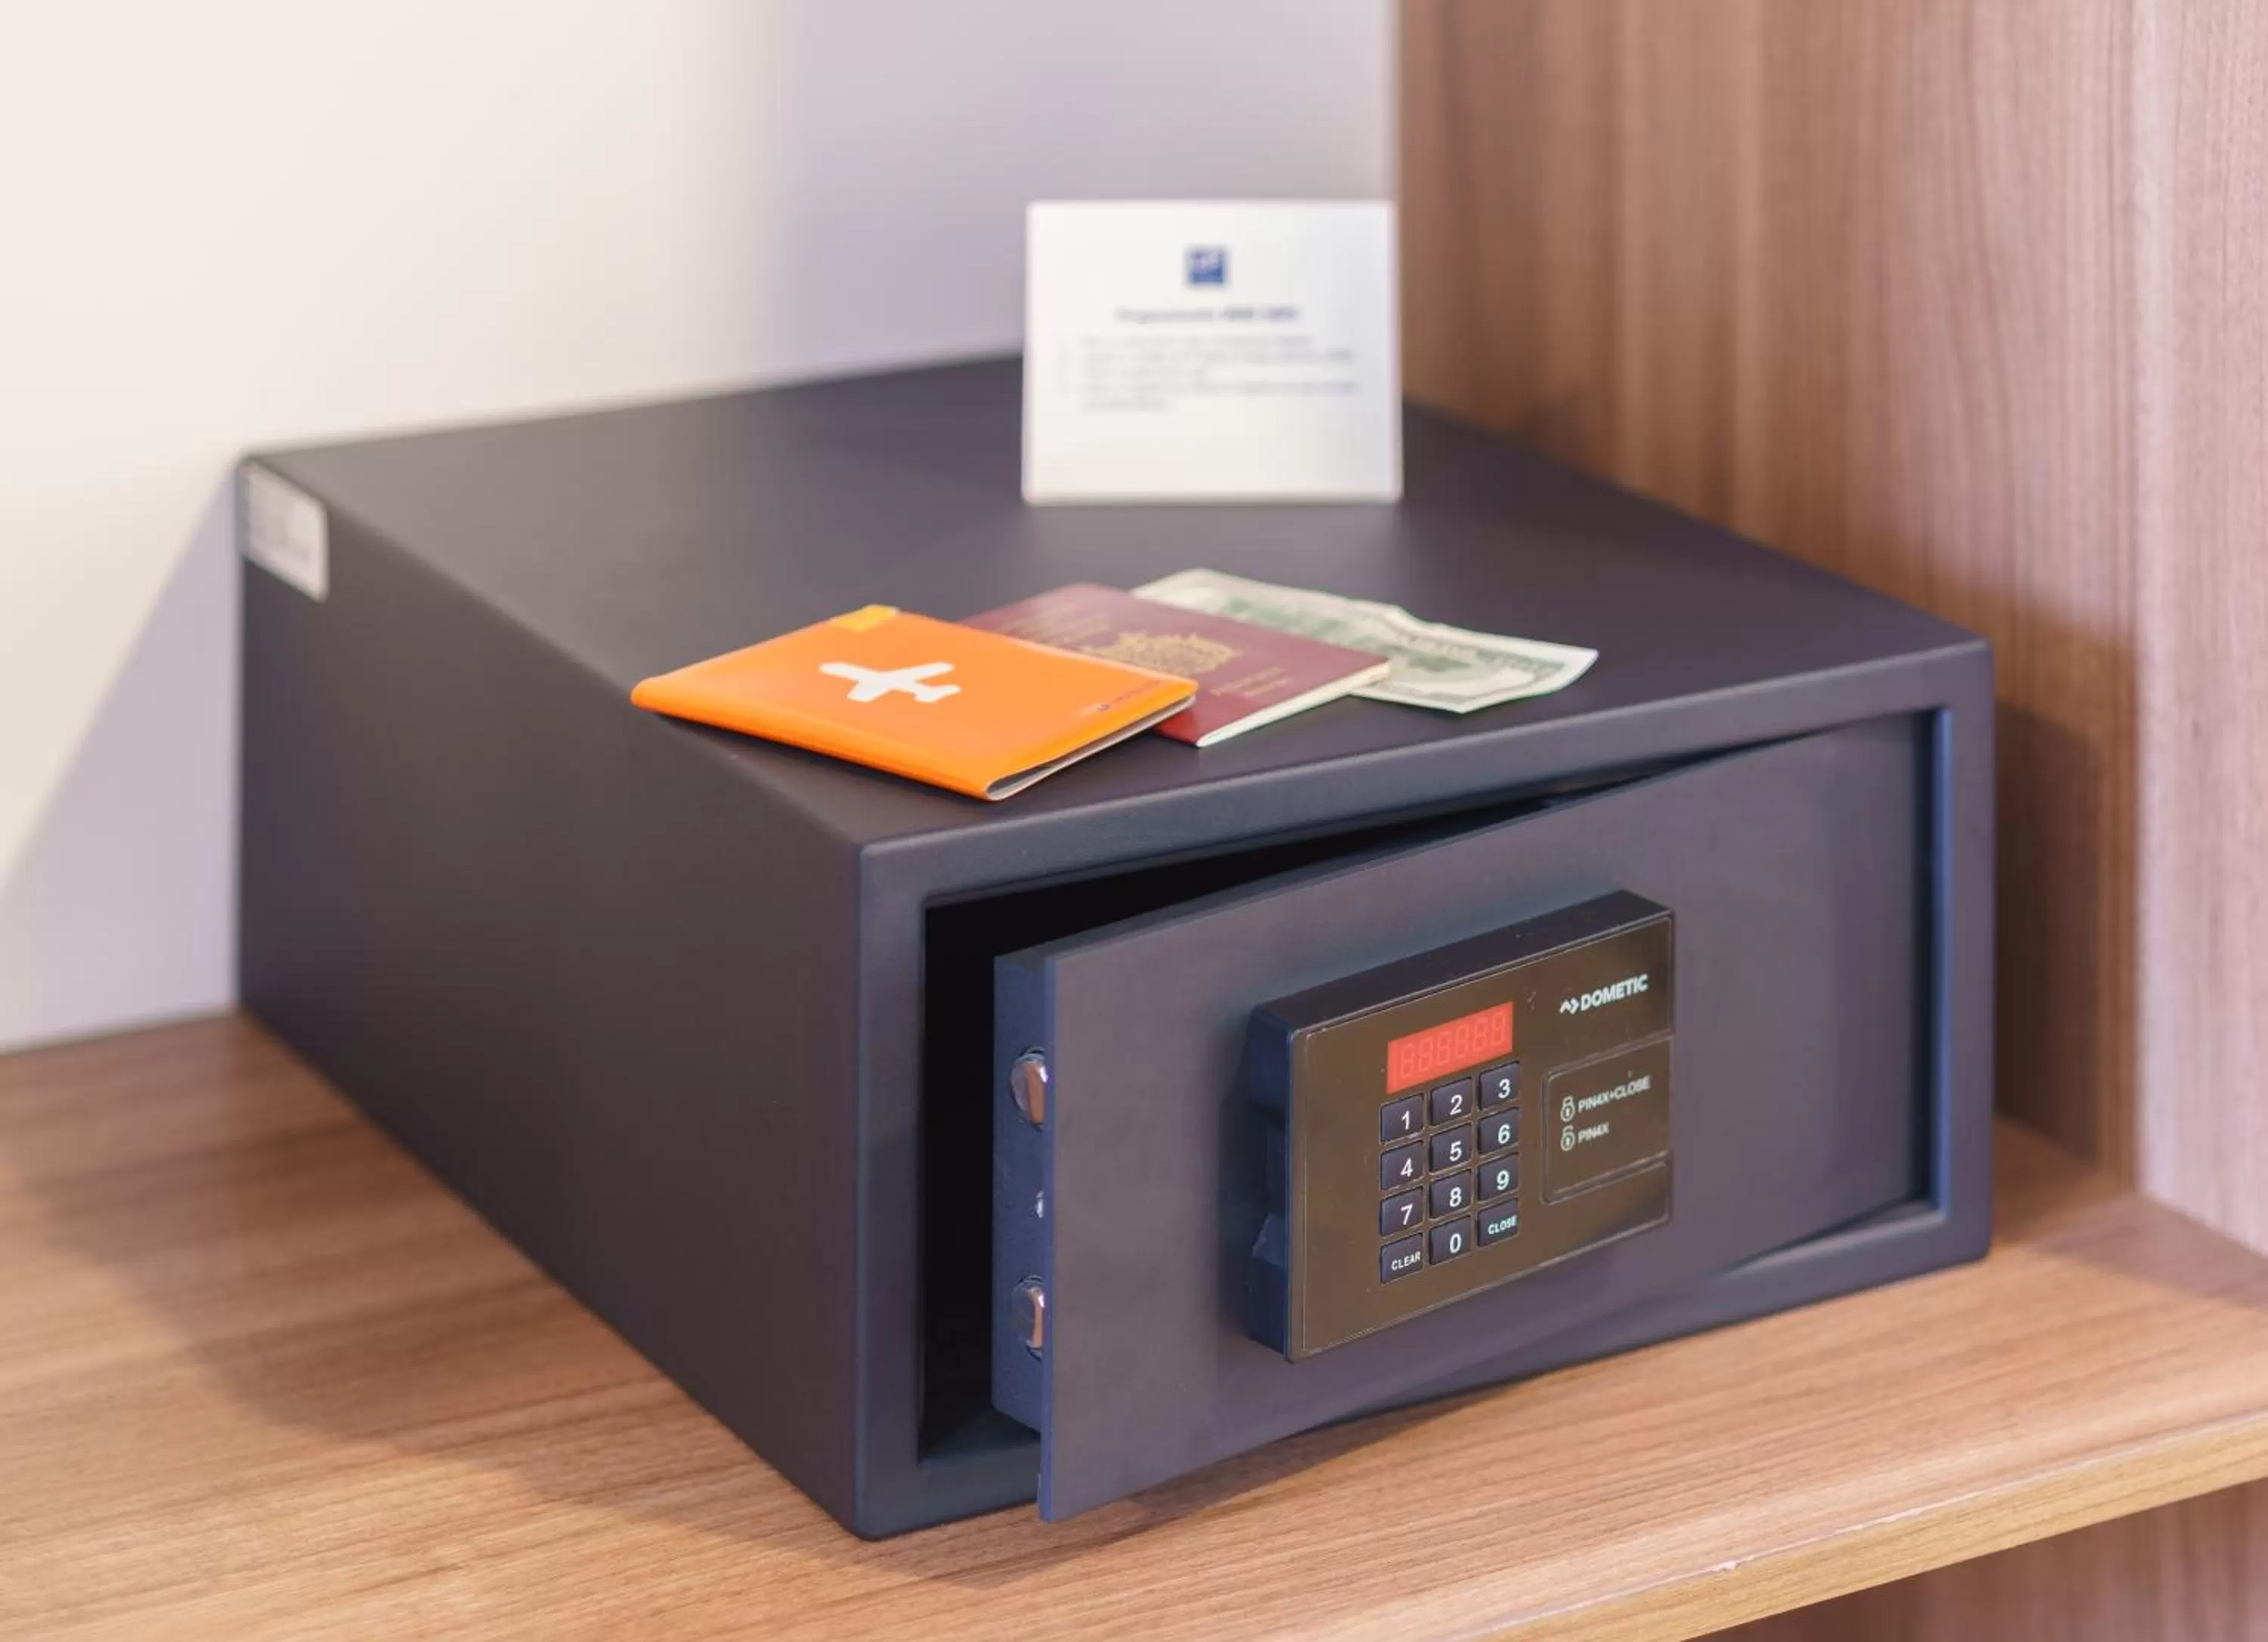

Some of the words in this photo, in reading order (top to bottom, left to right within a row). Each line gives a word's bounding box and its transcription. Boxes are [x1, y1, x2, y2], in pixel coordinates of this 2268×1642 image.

[1580, 973, 1649, 1012] DOMETIC
[1401, 1110, 1410, 1130] 1
[1449, 1094, 1463, 1115] 2
[1498, 1078, 1510, 1098] 3
[1400, 1157, 1413, 1177] 4
[1449, 1141, 1462, 1161] 5
[1498, 1123, 1510, 1144] 6
[1400, 1204, 1413, 1225] 7
[1449, 1187, 1462, 1207] 8
[1496, 1170, 1510, 1191] 9
[1391, 1251, 1421, 1271] CLEAR
[1449, 1233, 1462, 1253] 0
[1487, 1214, 1517, 1235] CLOSE
